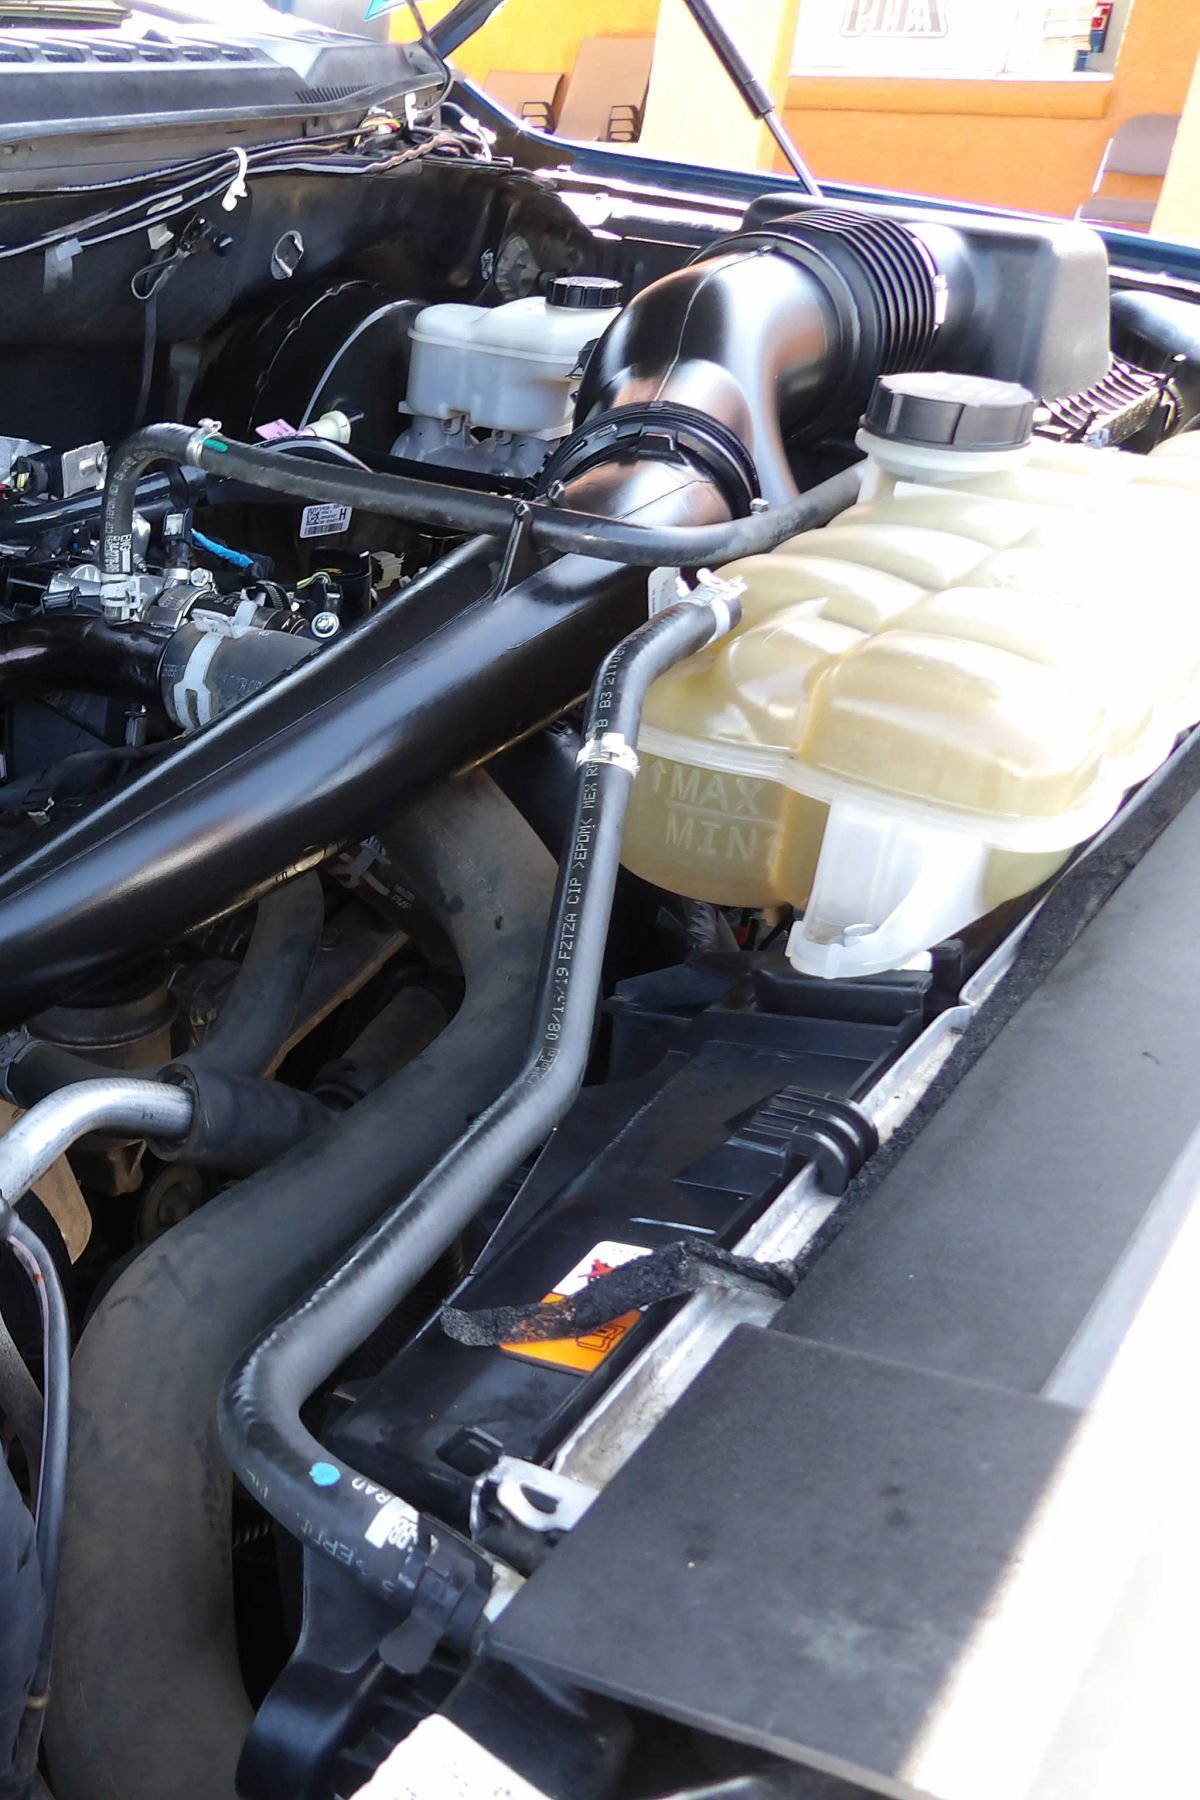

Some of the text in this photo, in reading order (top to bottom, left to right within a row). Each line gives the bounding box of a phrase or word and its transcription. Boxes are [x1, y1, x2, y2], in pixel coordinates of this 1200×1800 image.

[338, 507, 348, 521] H
[582, 782, 599, 809] MEX
[670, 764, 767, 815] MAX
[664, 811, 758, 862] MIN
[566, 877, 583, 904] CIP
[558, 912, 578, 960] FZTZA
